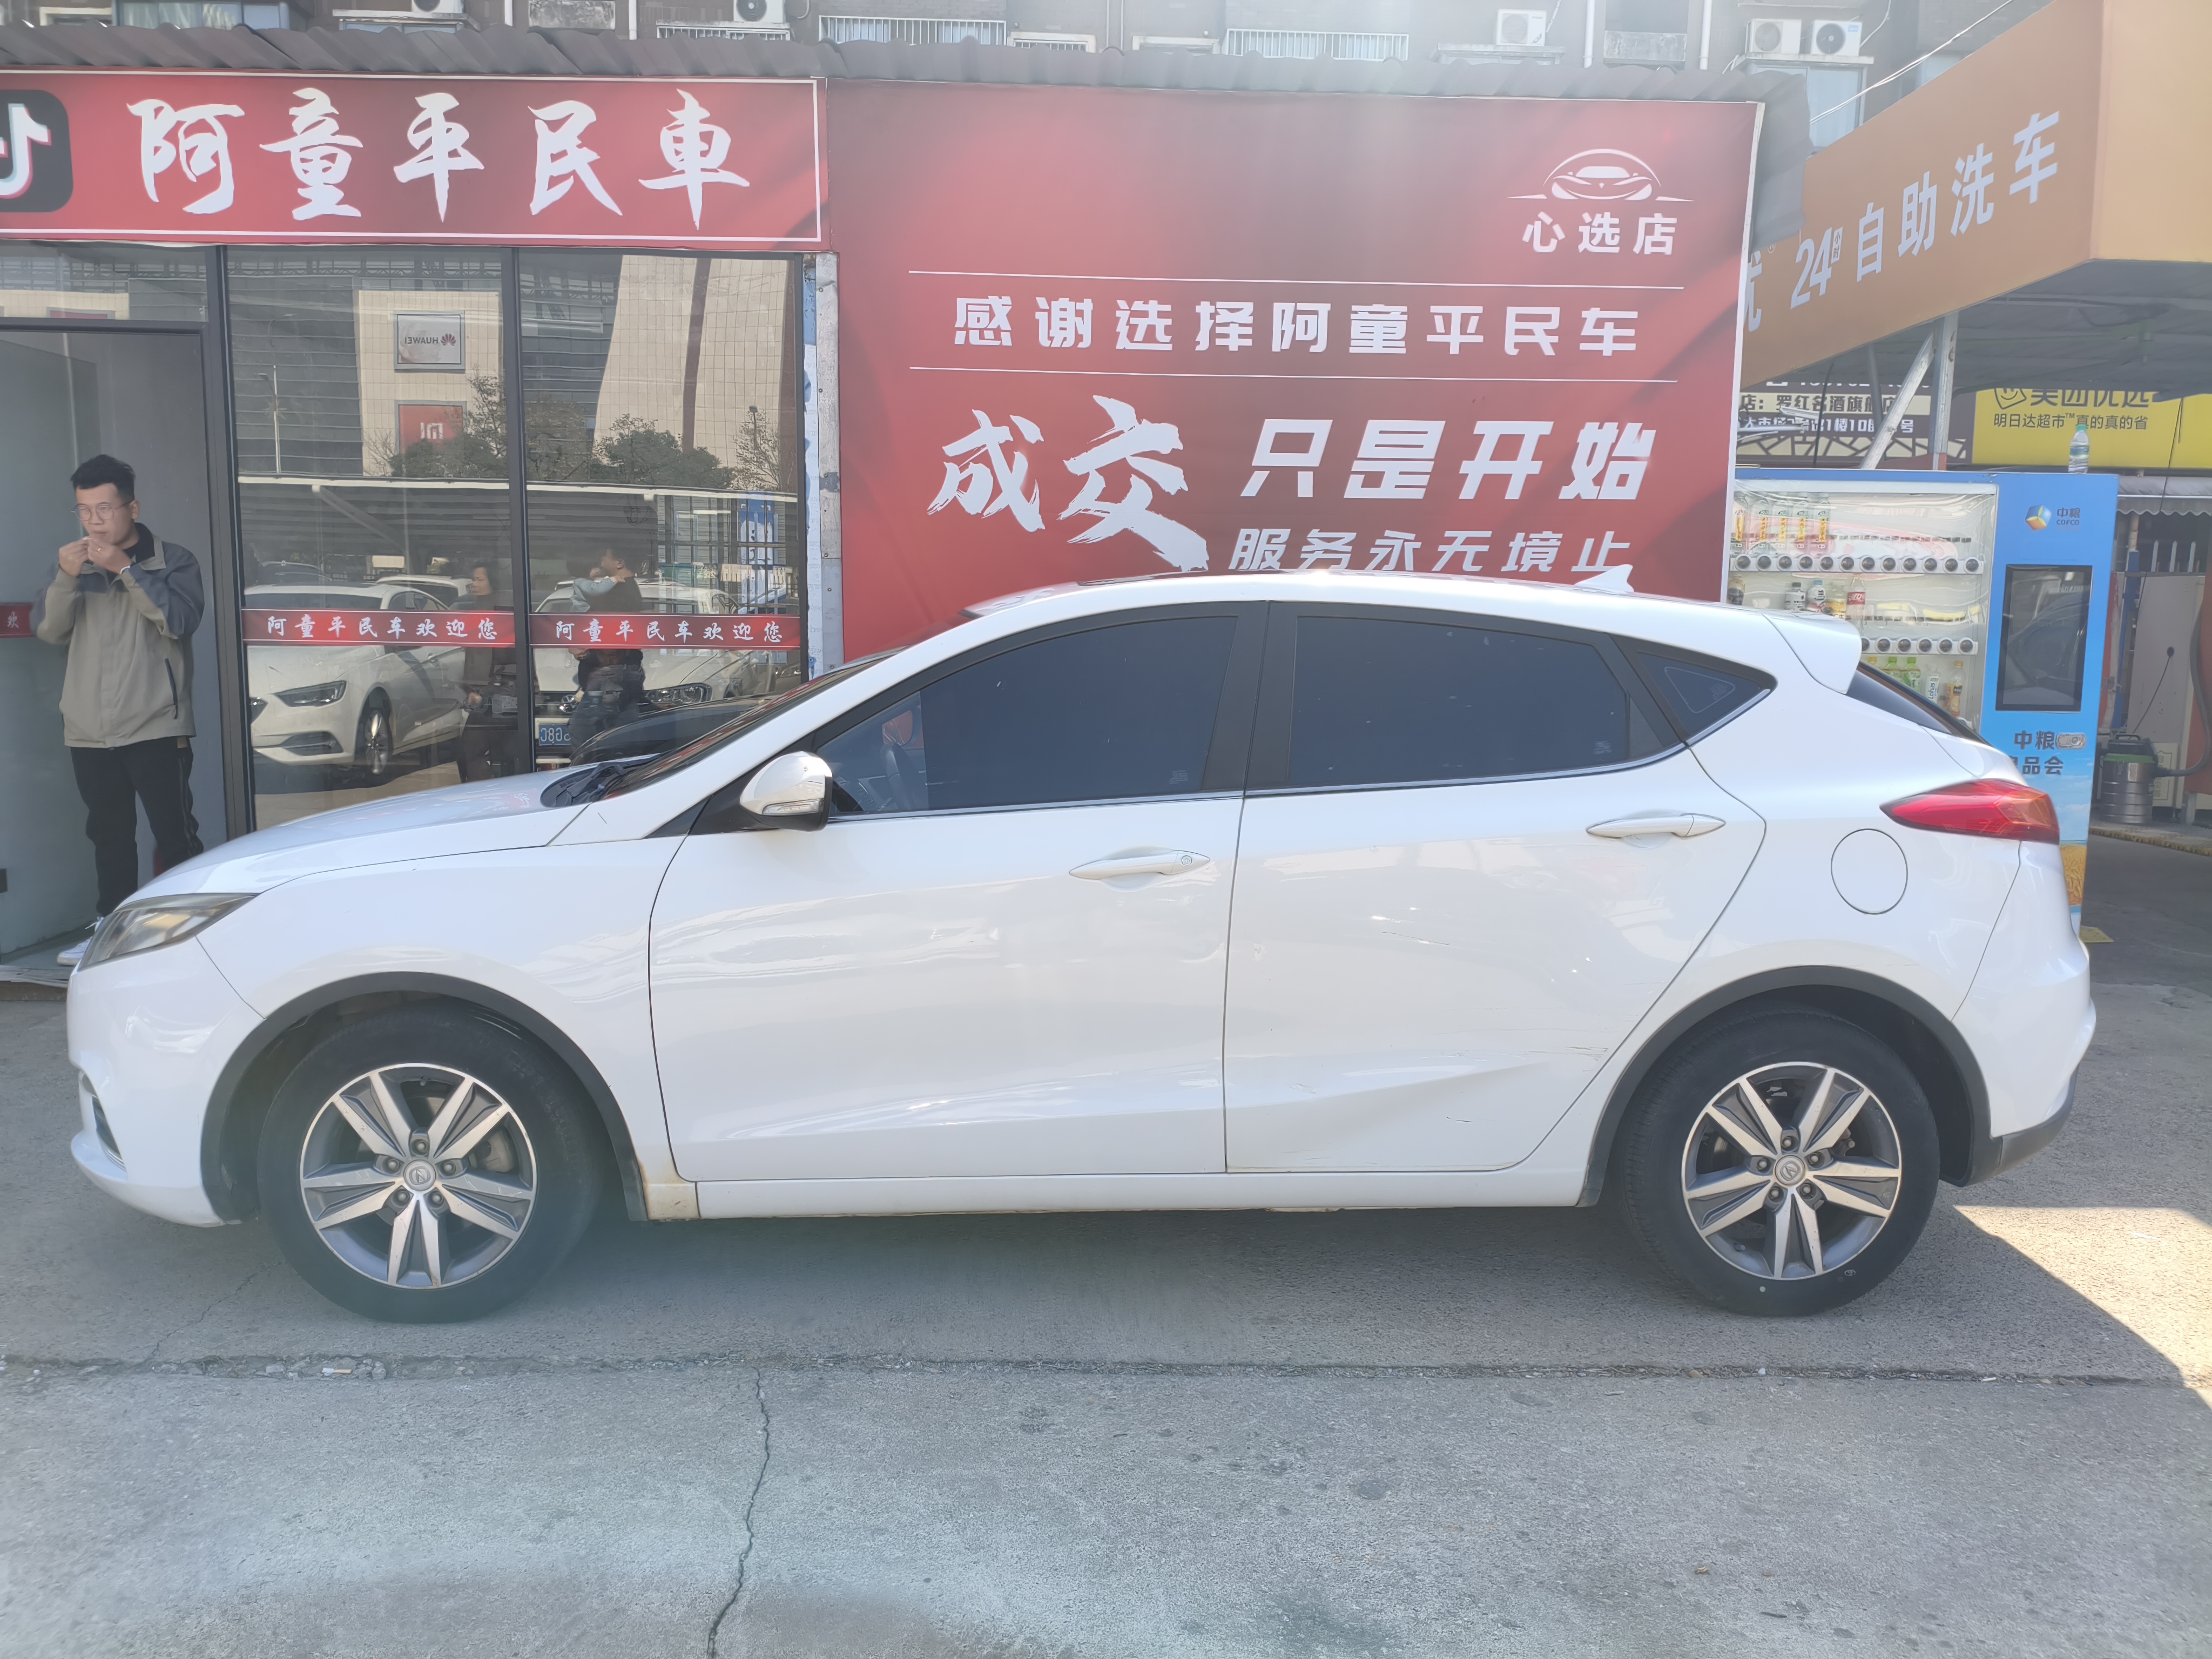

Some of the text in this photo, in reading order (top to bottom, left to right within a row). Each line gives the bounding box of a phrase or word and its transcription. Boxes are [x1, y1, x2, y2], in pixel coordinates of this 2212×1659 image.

[1522, 211, 1677, 255] 心选店
[954, 295, 1639, 356] 感谢选择阿童平民车
[927, 395, 1210, 572] 成交
[1240, 419, 1657, 500] 只是开始
[2056, 507, 2081, 518] 中粮
[1228, 528, 1630, 572] 服务永无境止
[267, 614, 498, 640] 阿童平民车欢迎您
[556, 618, 783, 643] 阿童平民车欢迎您
[2014, 730, 2055, 750] 中粮
